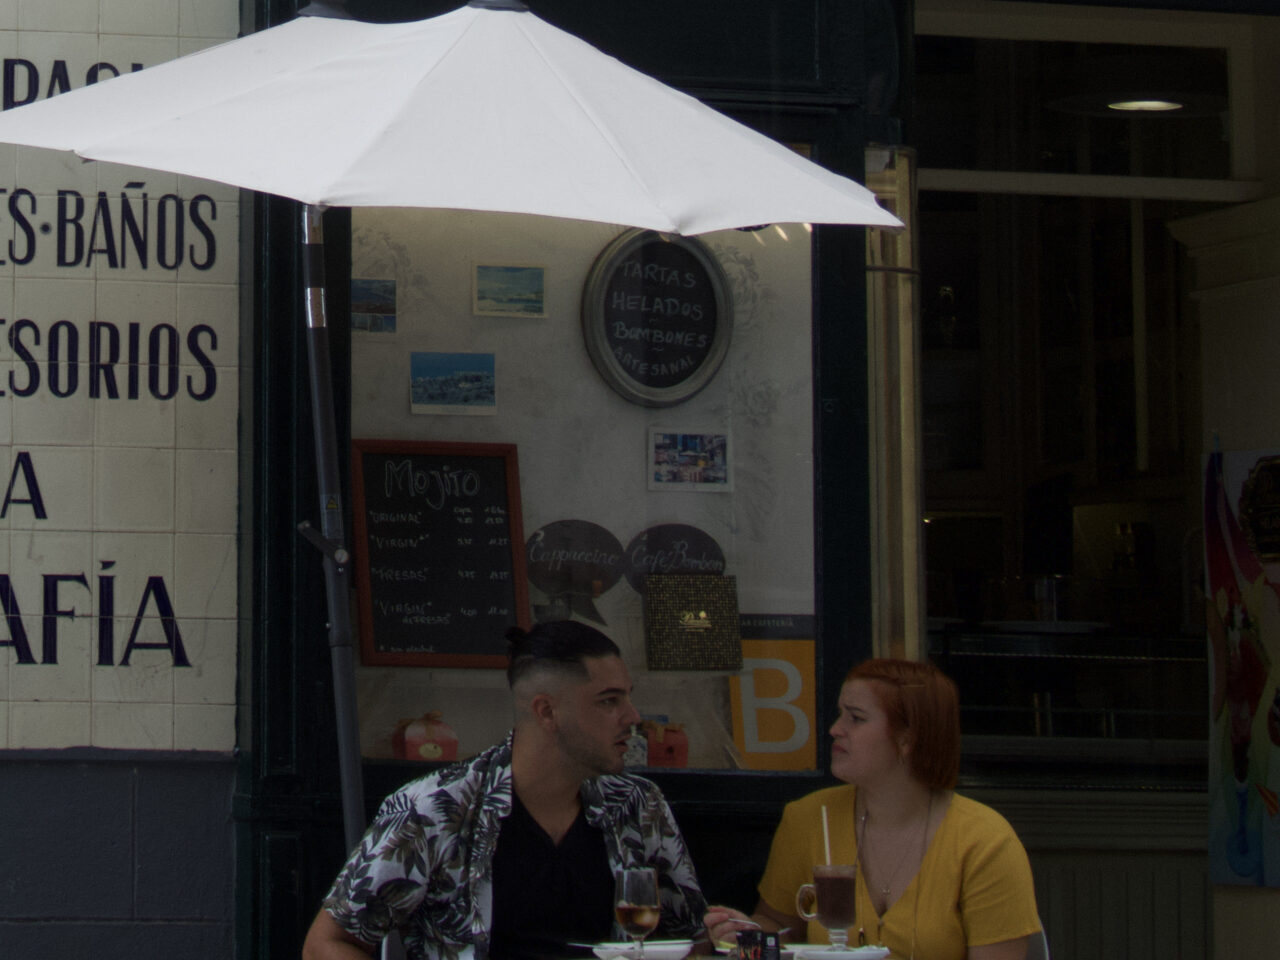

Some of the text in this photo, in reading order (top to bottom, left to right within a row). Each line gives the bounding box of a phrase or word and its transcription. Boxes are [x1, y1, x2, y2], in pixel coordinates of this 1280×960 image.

[56, 182, 217, 271] BAÑOS
[623, 261, 696, 288] TARTAS
[612, 291, 704, 321] HELADOS
